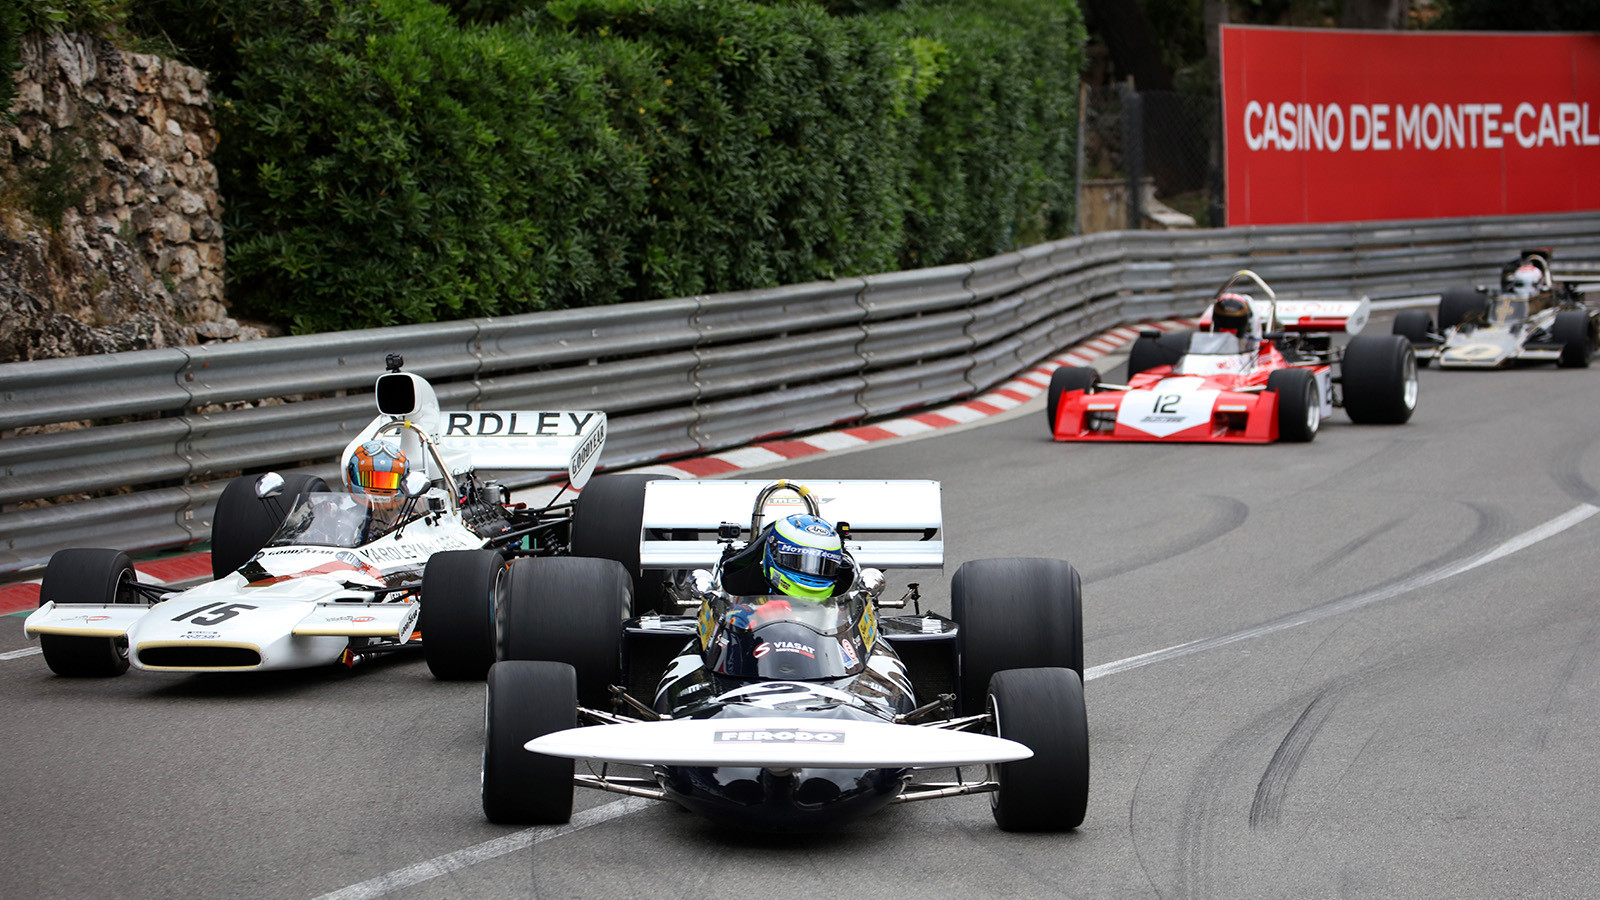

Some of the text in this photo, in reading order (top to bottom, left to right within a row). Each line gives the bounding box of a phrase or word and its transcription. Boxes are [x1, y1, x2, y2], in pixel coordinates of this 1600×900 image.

[1244, 101, 1600, 151] CASINO DE MONTE-CARL
[1153, 394, 1181, 414] 12
[360, 544, 423, 564] YARDLEY
[170, 602, 260, 626] 15
[773, 641, 816, 655] VIASAT
[721, 731, 837, 742] FERODO
